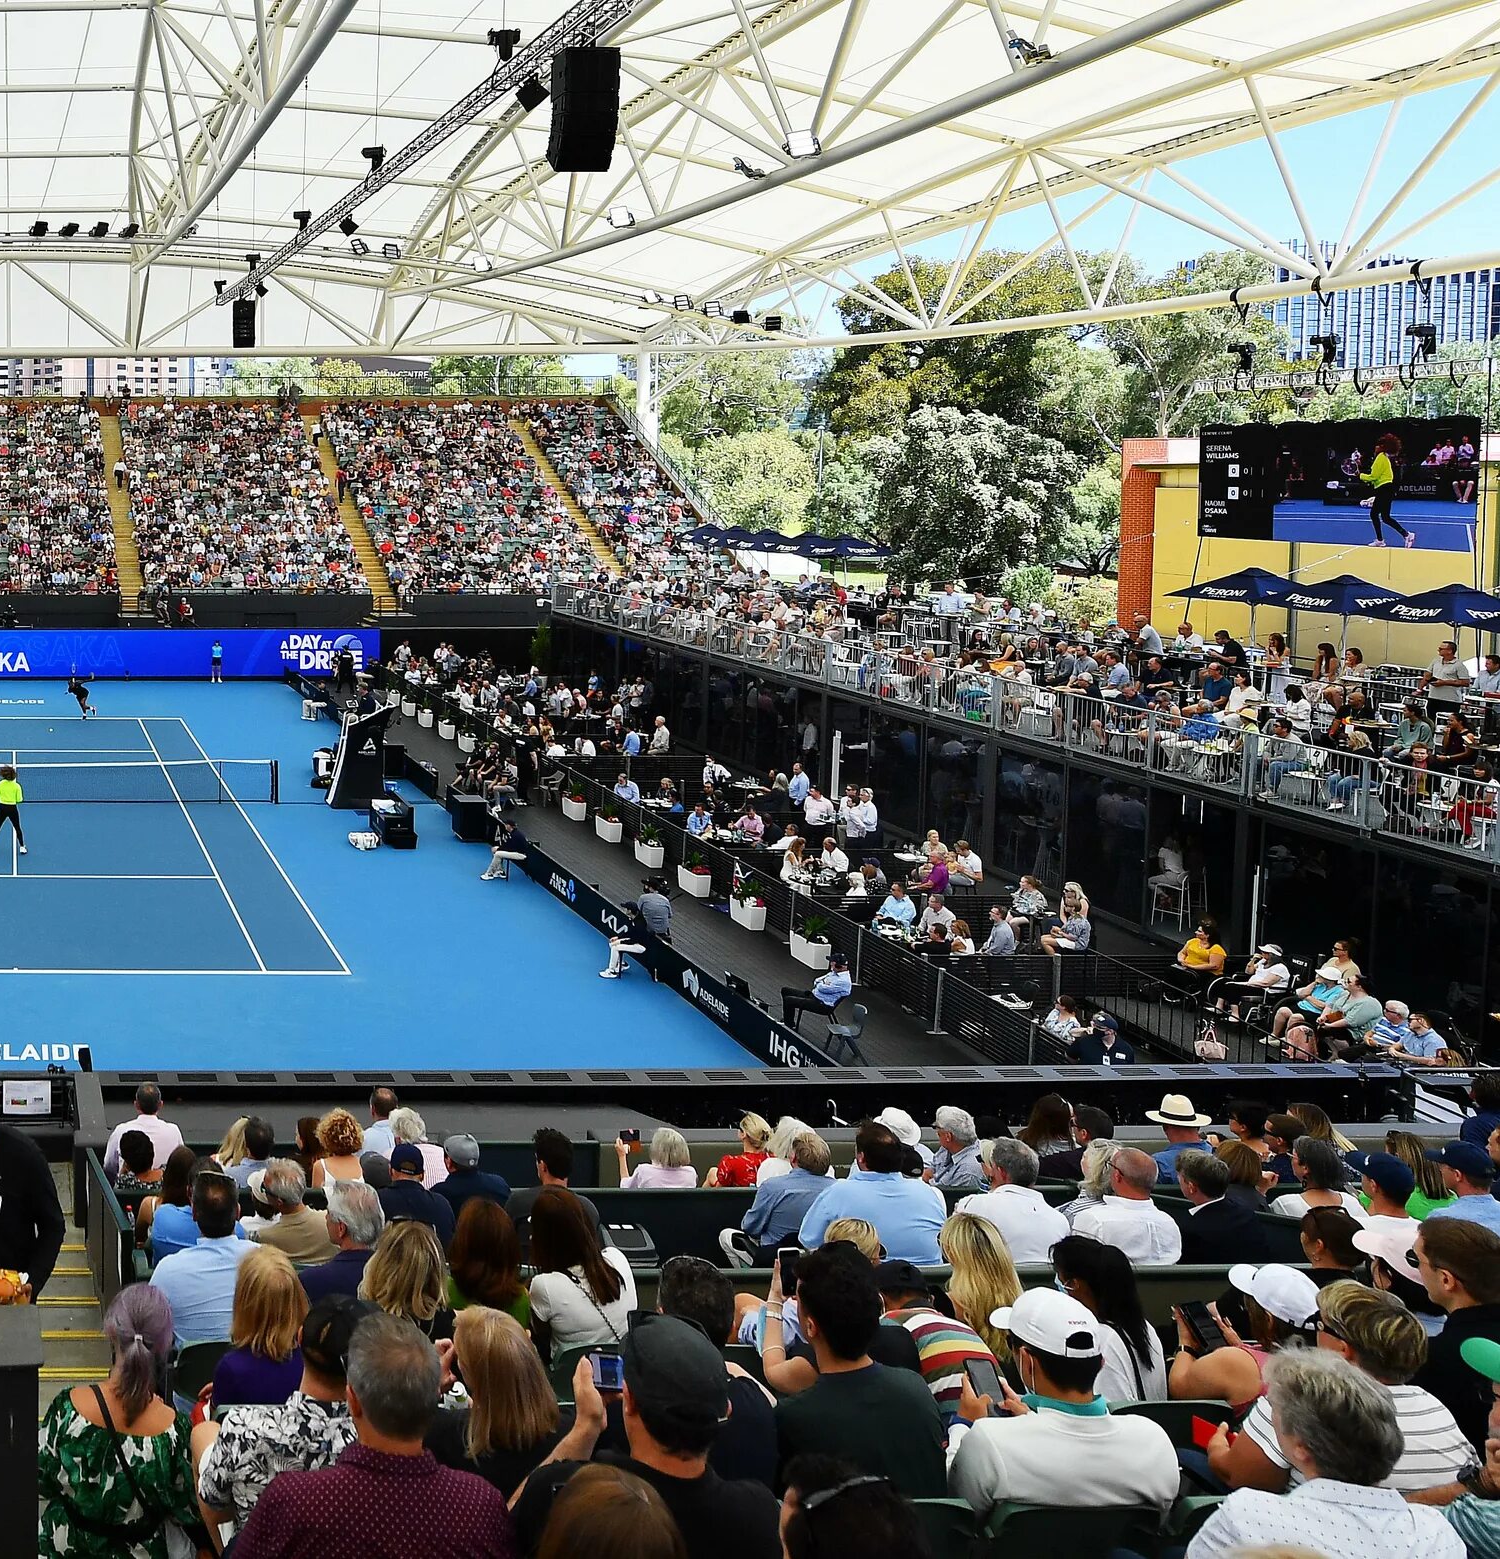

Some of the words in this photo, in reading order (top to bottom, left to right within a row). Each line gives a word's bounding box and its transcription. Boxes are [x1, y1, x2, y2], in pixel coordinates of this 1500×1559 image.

[1205, 444, 1232, 452] SERENA
[1204, 507, 1228, 515] OSAKA
[1200, 586, 1248, 598] PERONI
[1285, 593, 1333, 608] PERONI
[1389, 603, 1443, 618] PERONI
[280, 640, 289, 650] A
[289, 634, 323, 650] DAY
[320, 640, 333, 650] AT
[280, 651, 299, 660] THE
[549, 871, 567, 897] ANZ
[699, 987, 730, 1018] ADELAIDE
[768, 1029, 801, 1067] IHG
